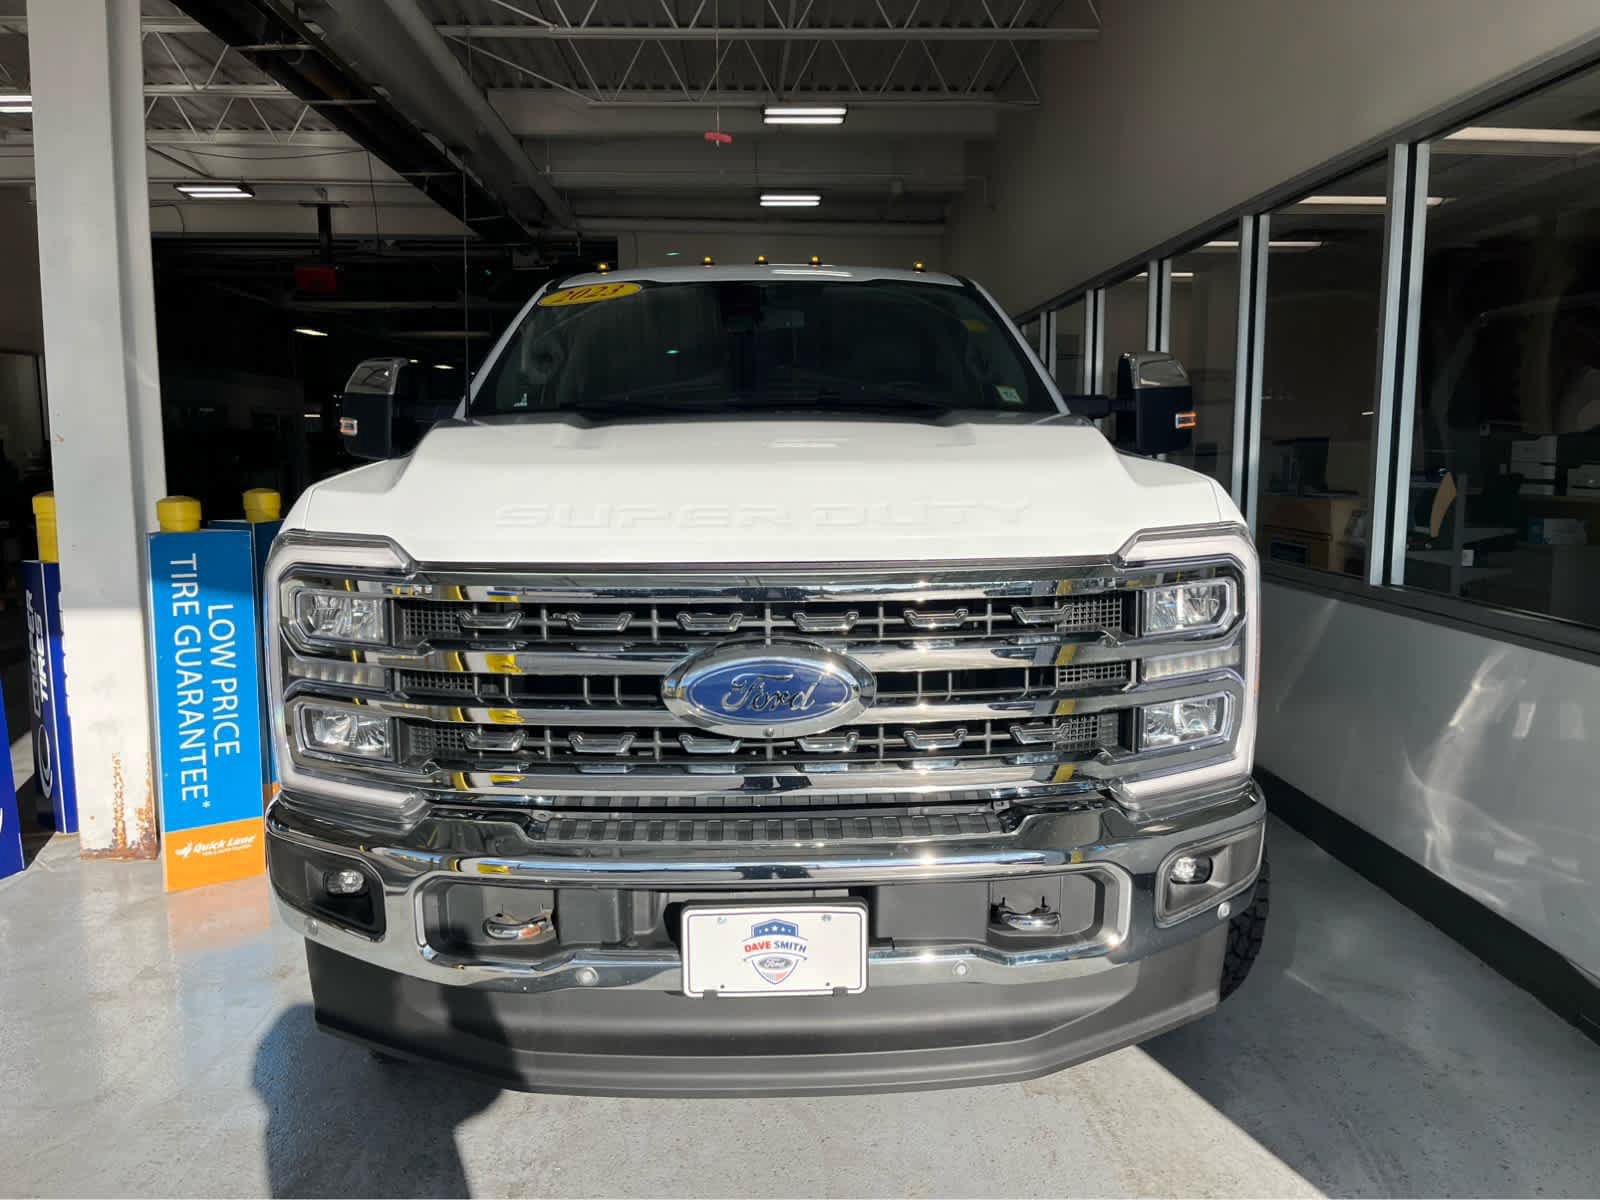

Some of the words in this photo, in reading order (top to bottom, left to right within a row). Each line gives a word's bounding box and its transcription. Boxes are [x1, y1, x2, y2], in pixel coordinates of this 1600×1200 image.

[552, 283, 625, 303] 2023
[496, 502, 793, 529] SUPER
[811, 496, 1033, 529] DUTY
[170, 553, 200, 616] TIRE
[208, 604, 236, 668] LOW
[721, 673, 822, 711] Ford
[211, 678, 240, 757] PRICE
[193, 840, 225, 853] Quick
[226, 833, 256, 847] Lane
[744, 940, 772, 953] DAVE
[773, 940, 807, 953] SMITH
